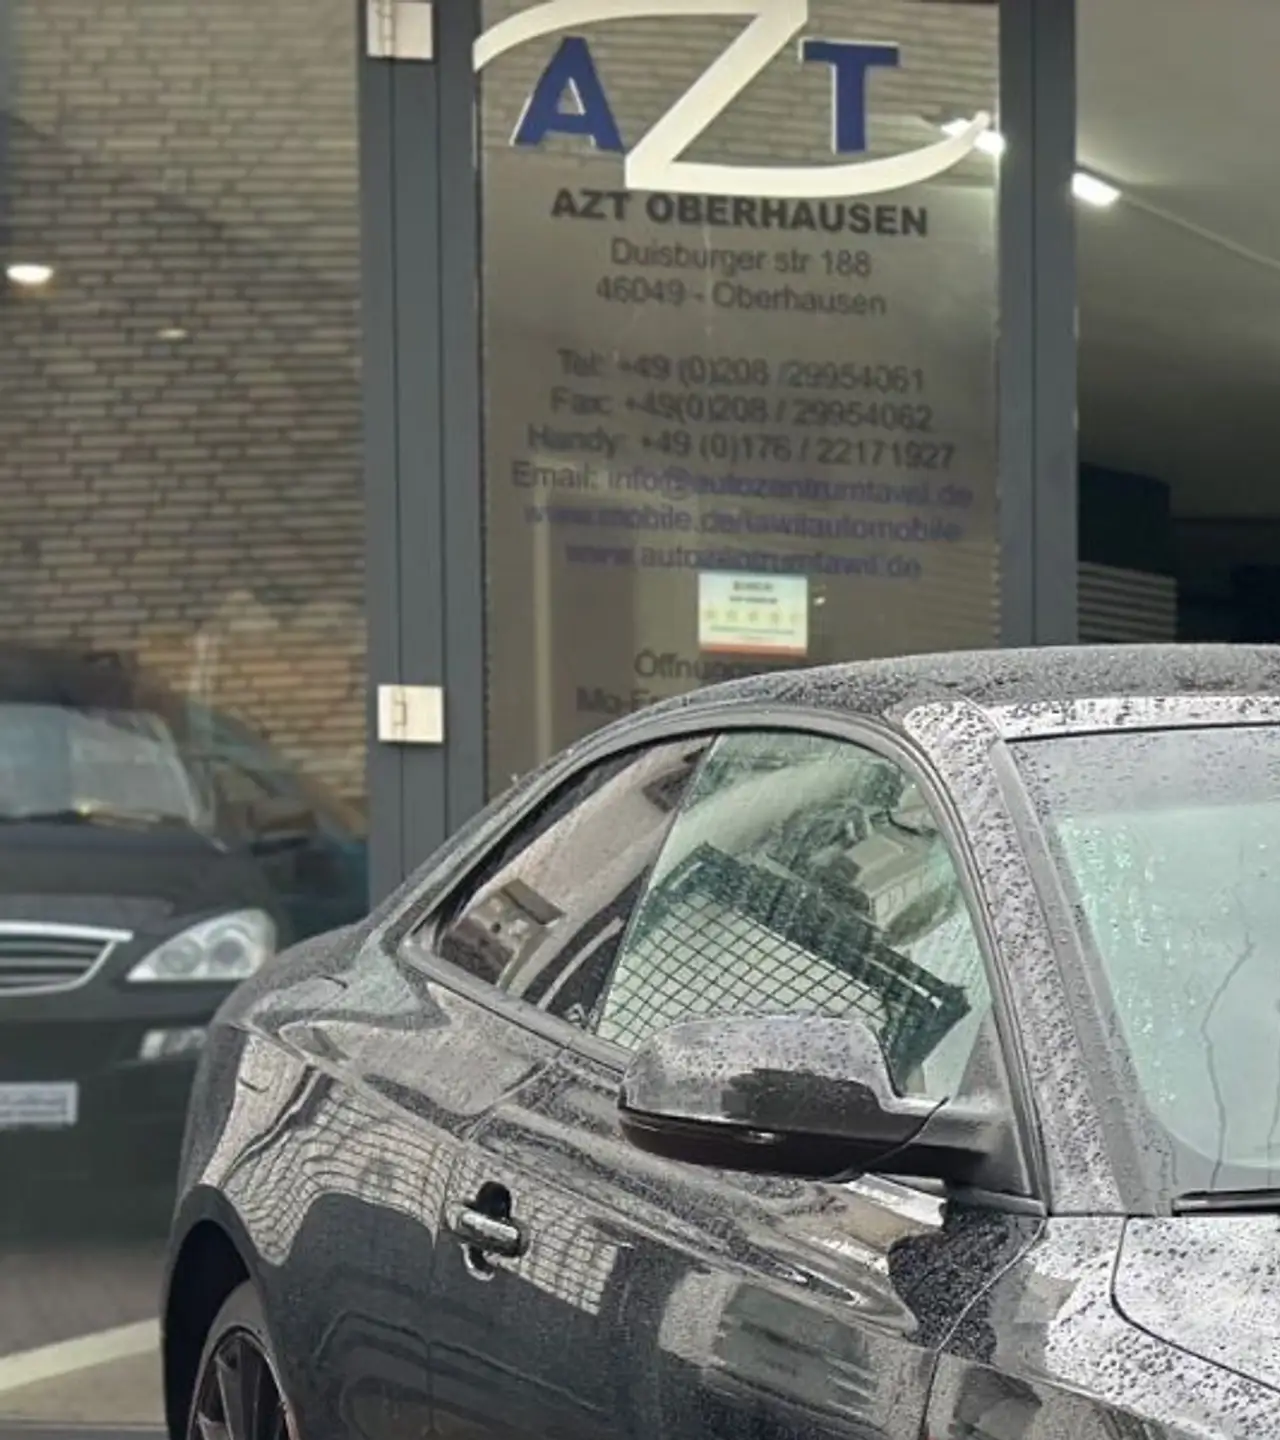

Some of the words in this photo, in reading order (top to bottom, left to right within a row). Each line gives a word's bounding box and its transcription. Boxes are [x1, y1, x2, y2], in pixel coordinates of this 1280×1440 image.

[473, 0, 992, 197] AZT
[551, 187, 631, 220] AZT
[646, 192, 928, 237] OBERHAUSEN
[611, 236, 766, 276] Duisburger
[773, 248, 812, 273] str
[821, 249, 872, 277] 188
[597, 276, 686, 306] 46049
[712, 280, 887, 315] Oberhausen
[816, 437, 956, 470] 22171927
